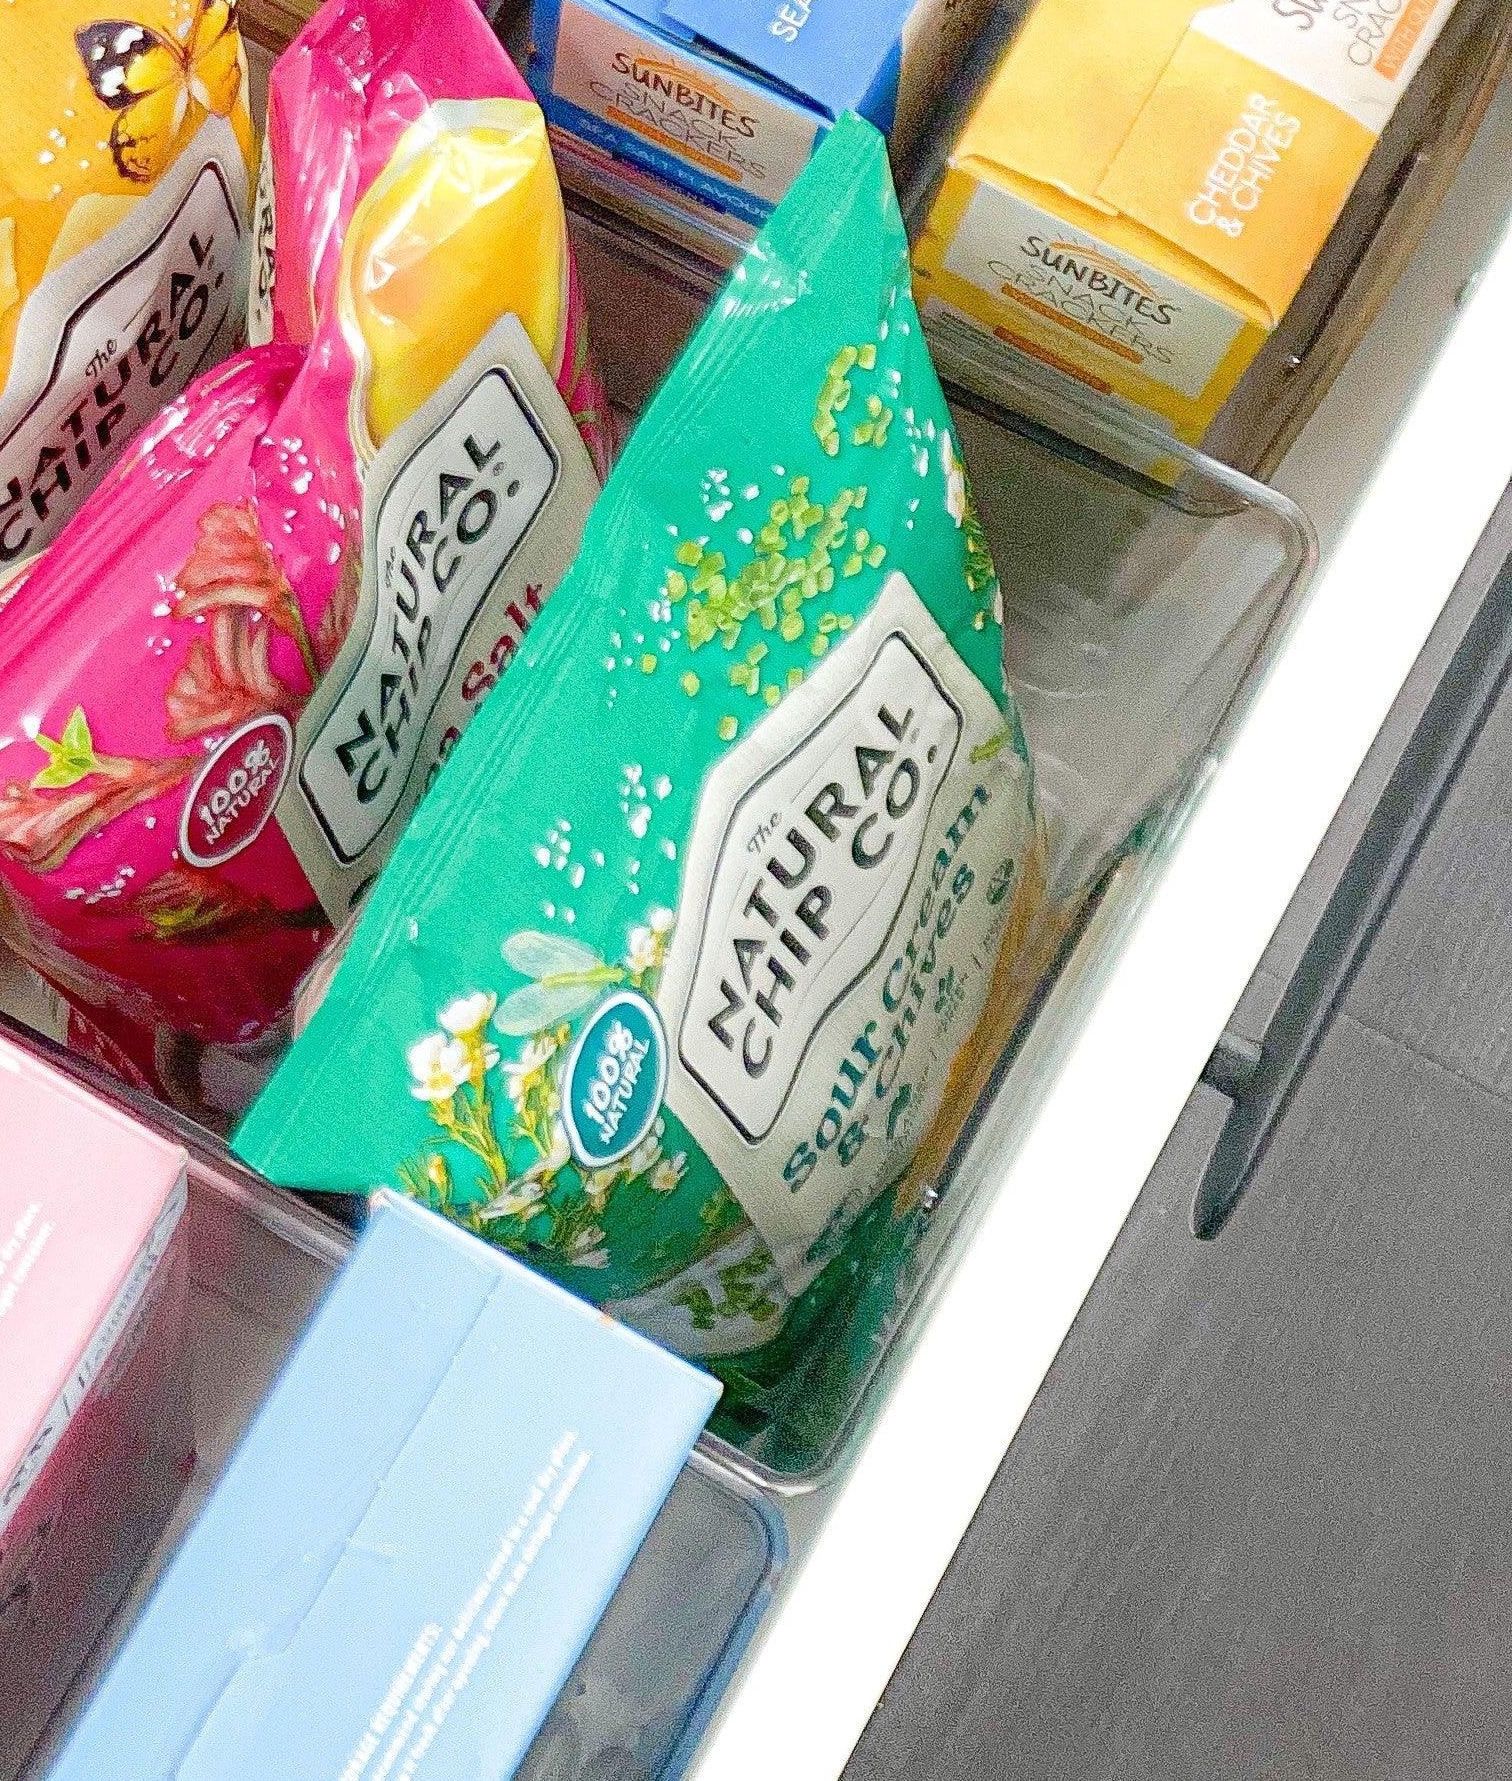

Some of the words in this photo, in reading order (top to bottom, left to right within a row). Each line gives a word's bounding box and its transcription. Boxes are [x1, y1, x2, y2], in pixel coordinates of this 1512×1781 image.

[612, 49, 761, 140] SUNBITES
[1383, 21, 1417, 67] WITH
[590, 79, 765, 181] CRACKERS
[623, 84, 738, 149] SNACK
[1187, 89, 1282, 229] CHEDDAR
[1213, 211, 1244, 238] &
[1230, 111, 1303, 214] CHIVES
[987, 255, 1175, 364] CRACKERS
[1019, 234, 1182, 329] SUNBITES
[1028, 262, 1143, 330] SNACK
[84, 338, 119, 381] The
[337, 432, 501, 776] NATURAL
[462, 582, 544, 704] Salt
[357, 617, 432, 806] CHIP
[200, 738, 272, 824] 100%
[203, 757, 287, 845] NATURAL
[708, 702, 914, 1052] NATURAL
[747, 812, 781, 856] The
[741, 885, 835, 1081] CHIP
[783, 1040, 876, 1193] Sour
[882, 785, 991, 1009] Cream
[583, 1021, 635, 1124] 100%
[597, 1038, 649, 1143] NATURAL
[838, 1120, 870, 1166] &
